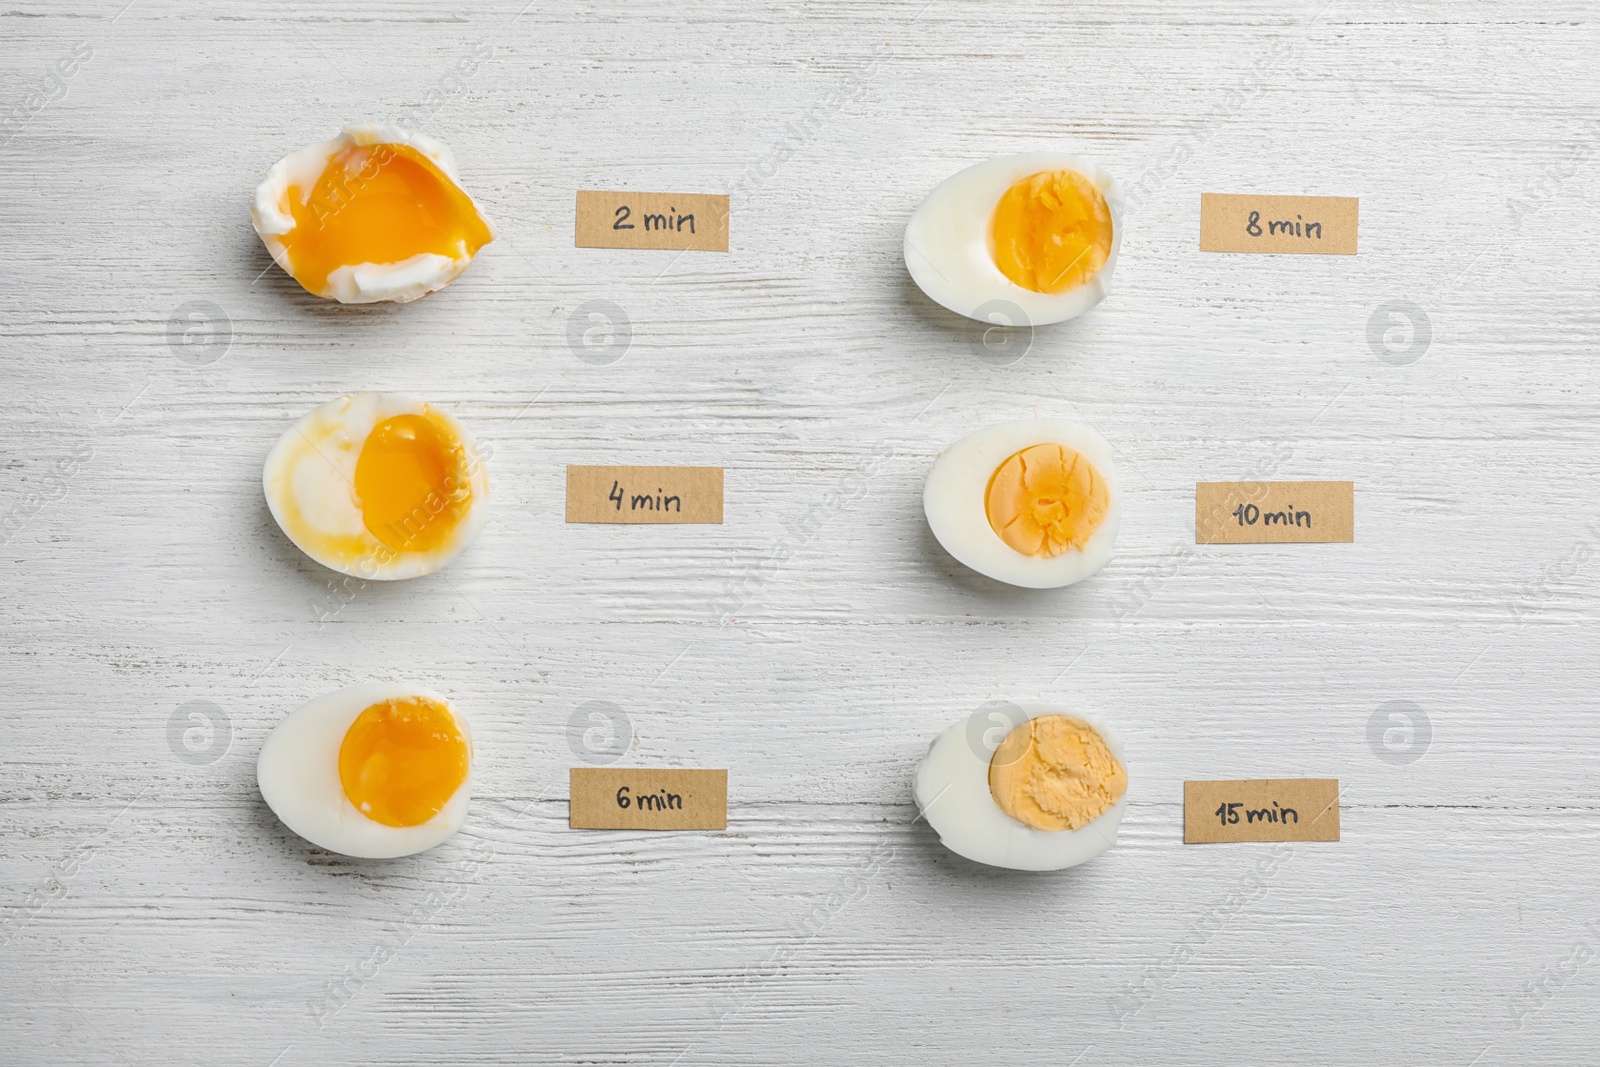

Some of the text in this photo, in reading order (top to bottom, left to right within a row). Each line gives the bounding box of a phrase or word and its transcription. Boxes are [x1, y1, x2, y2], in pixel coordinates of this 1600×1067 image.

[613, 205, 695, 234] 2 min
[1246, 211, 1322, 239] 8 min
[609, 480, 681, 513] 4 min
[1232, 503, 1311, 529] 10 min
[616, 786, 683, 812] 6 min
[1214, 800, 1299, 826] 15 min
